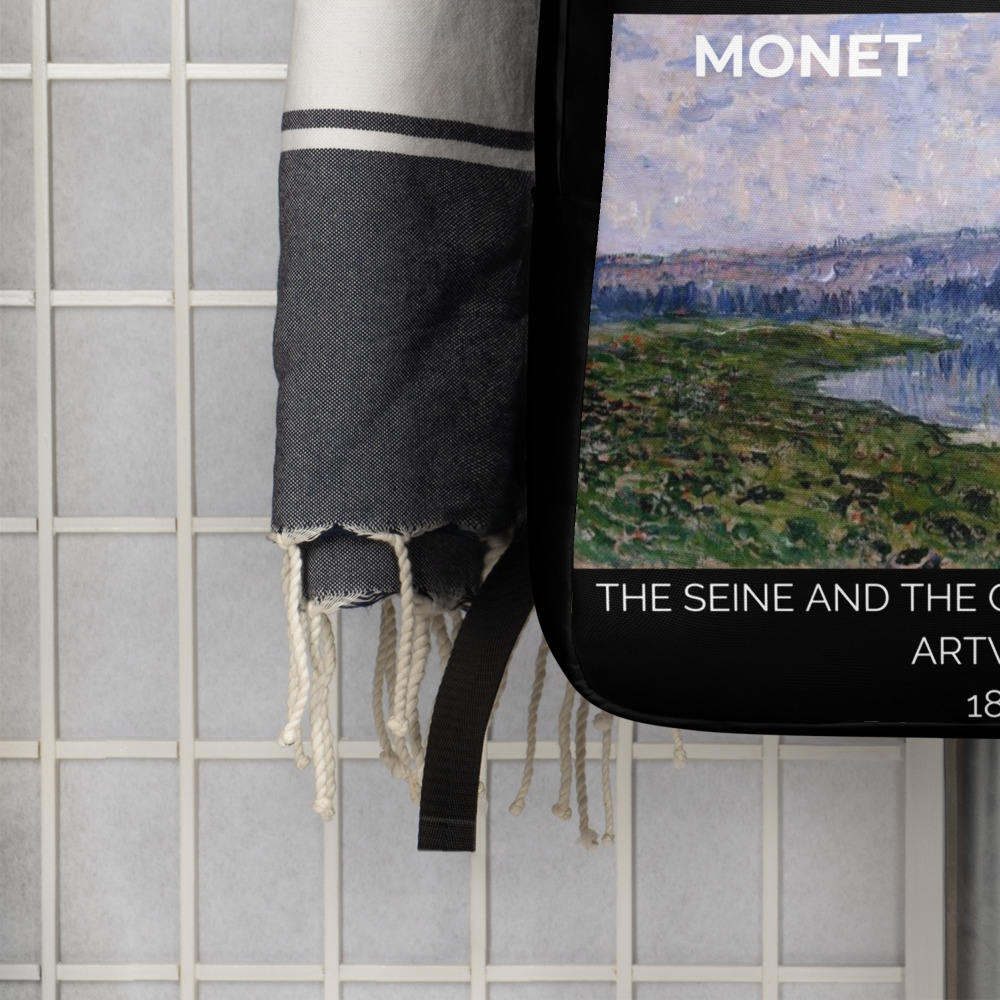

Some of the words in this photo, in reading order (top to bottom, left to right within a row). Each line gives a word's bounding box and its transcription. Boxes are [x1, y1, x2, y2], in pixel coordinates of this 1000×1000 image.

[695, 33, 922, 79] MONET
[595, 582, 672, 612] THE
[684, 582, 794, 612] SEINE
[805, 582, 890, 612] AND
[900, 582, 977, 612] THE
